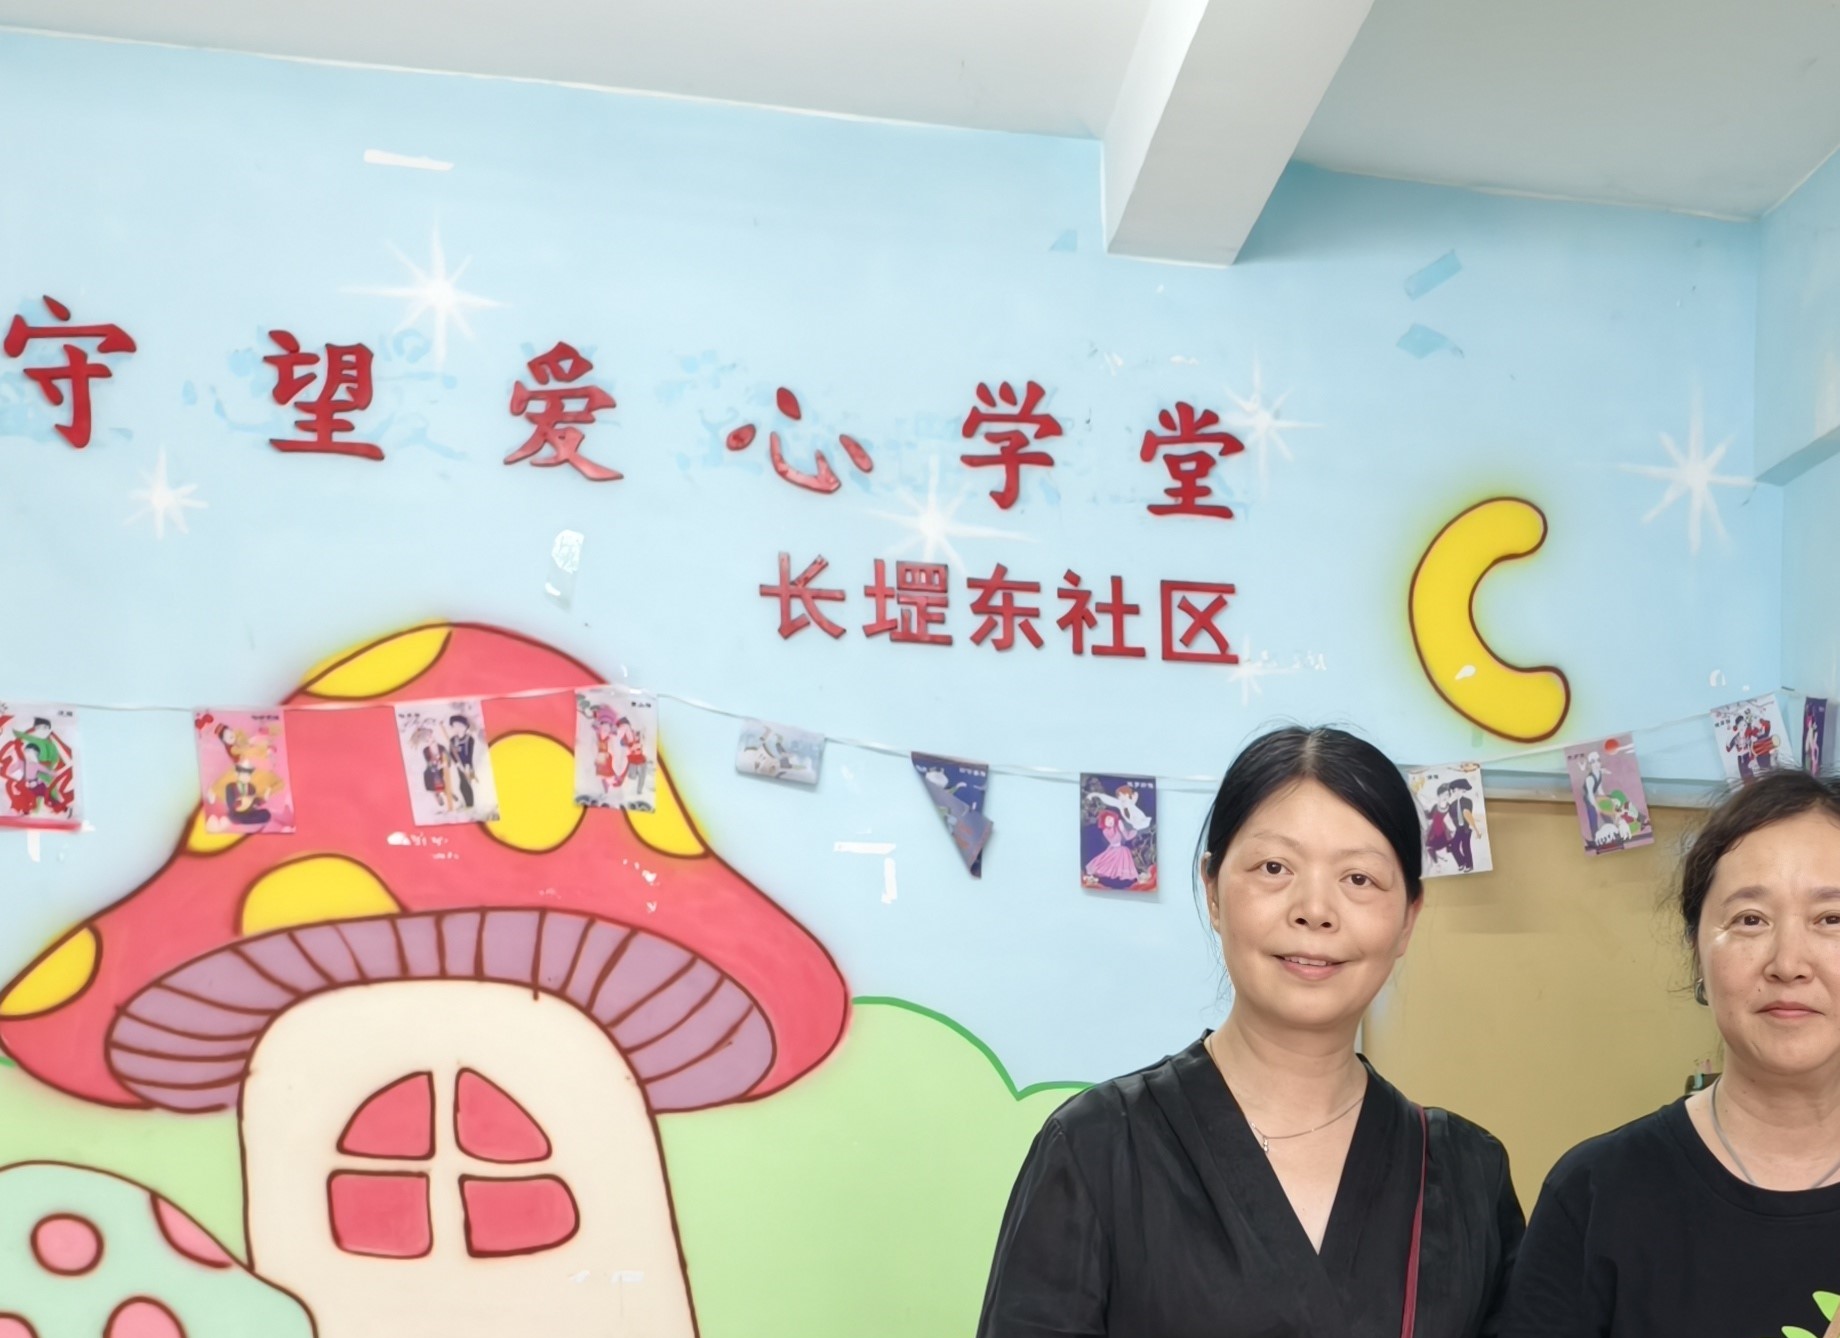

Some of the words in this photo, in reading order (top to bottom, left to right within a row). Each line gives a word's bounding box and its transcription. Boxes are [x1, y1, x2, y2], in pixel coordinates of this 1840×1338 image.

[3, 294, 1246, 520] 守望爱心学堂
[759, 552, 1239, 664] 长堽东社区
